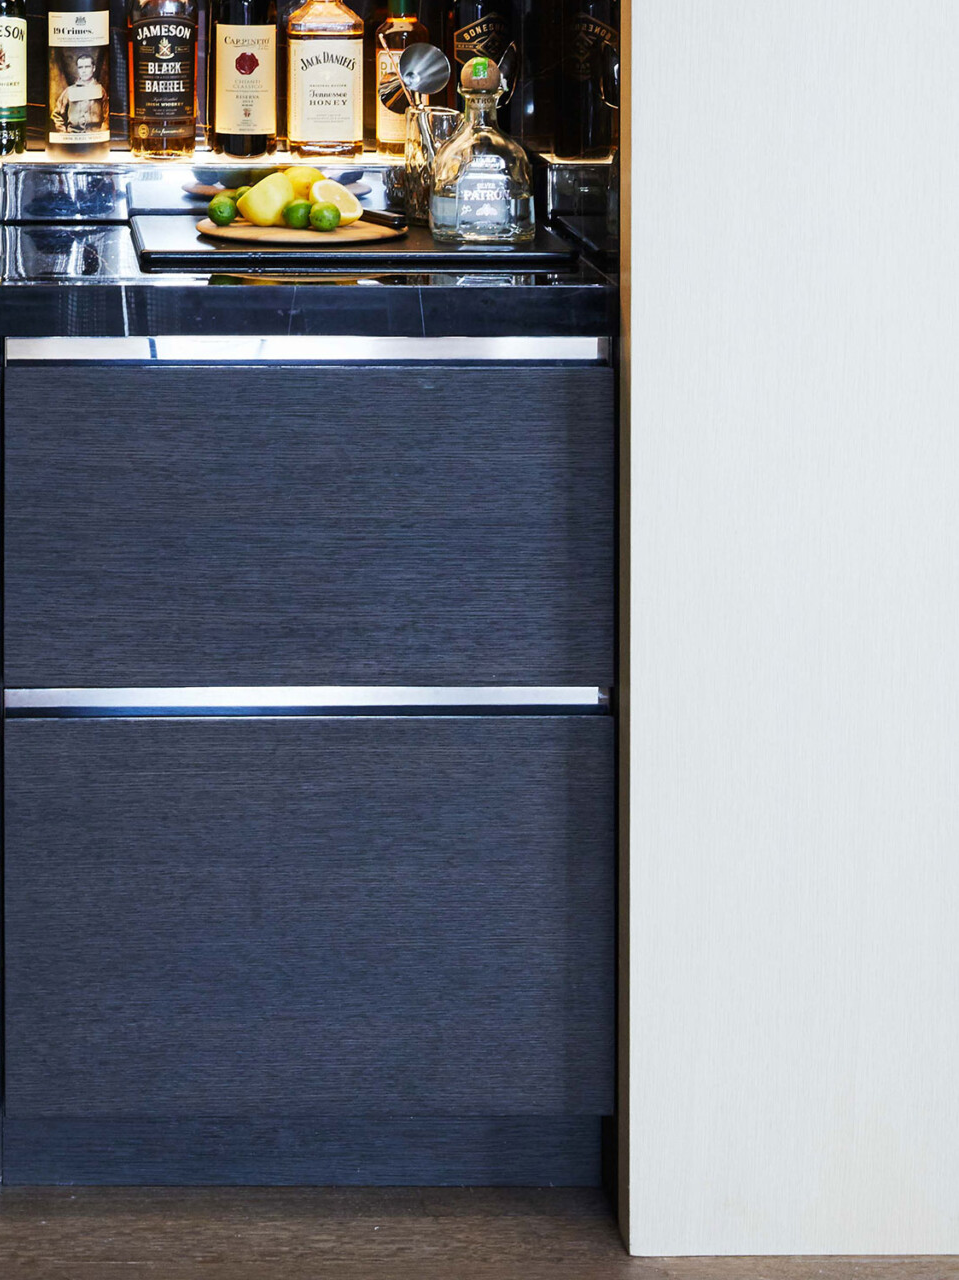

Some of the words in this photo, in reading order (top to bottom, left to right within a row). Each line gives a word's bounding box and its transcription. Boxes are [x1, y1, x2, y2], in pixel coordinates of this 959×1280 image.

[53, 27, 61, 35] 19
[136, 24, 191, 41] JAMESON
[300, 54, 322, 71] JACK
[322, 51, 357, 71] DANIEL'S
[147, 61, 182, 75] BLACK
[145, 80, 185, 93] BARREL
[309, 89, 348, 98] Tennessee
